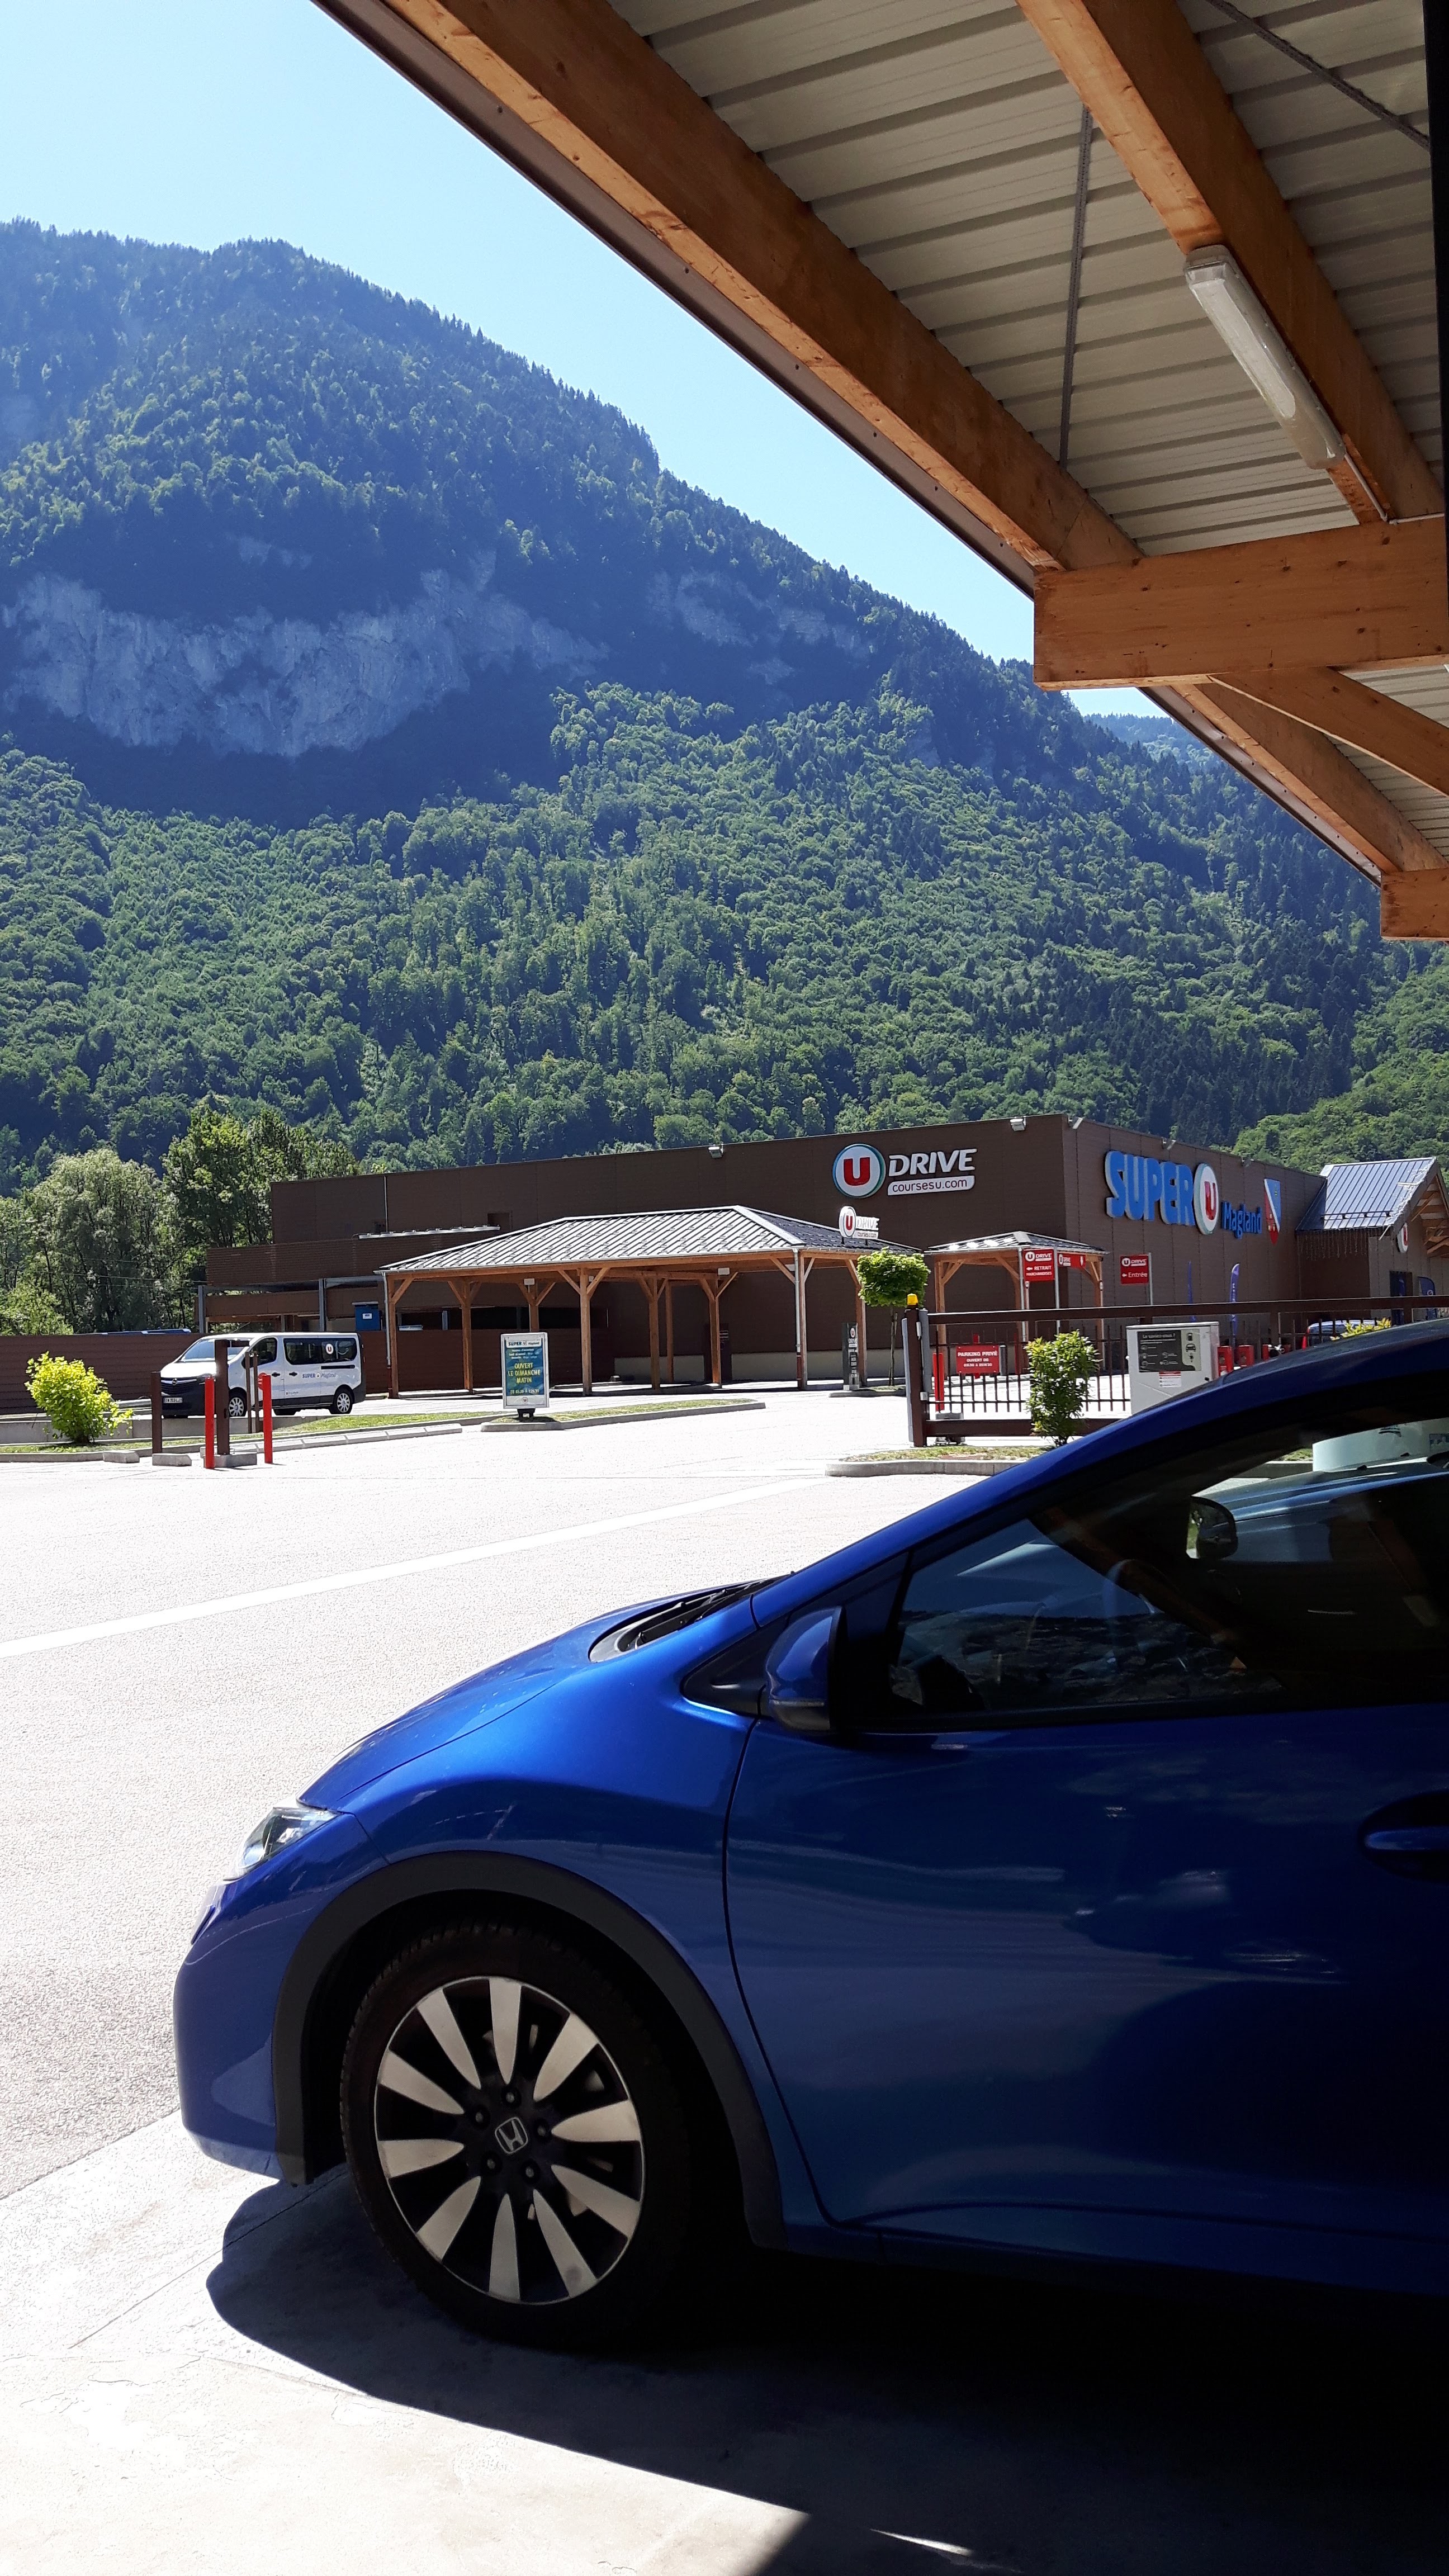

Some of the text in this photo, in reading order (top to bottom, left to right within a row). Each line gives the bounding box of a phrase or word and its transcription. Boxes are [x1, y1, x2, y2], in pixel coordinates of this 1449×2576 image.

[843, 1148, 977, 1186] U DRIVE
[892, 1179, 967, 1192] coursesu.com
[1105, 1150, 1262, 1239] SUPER U Magland
[846, 1215, 880, 1230] U DRIVE
